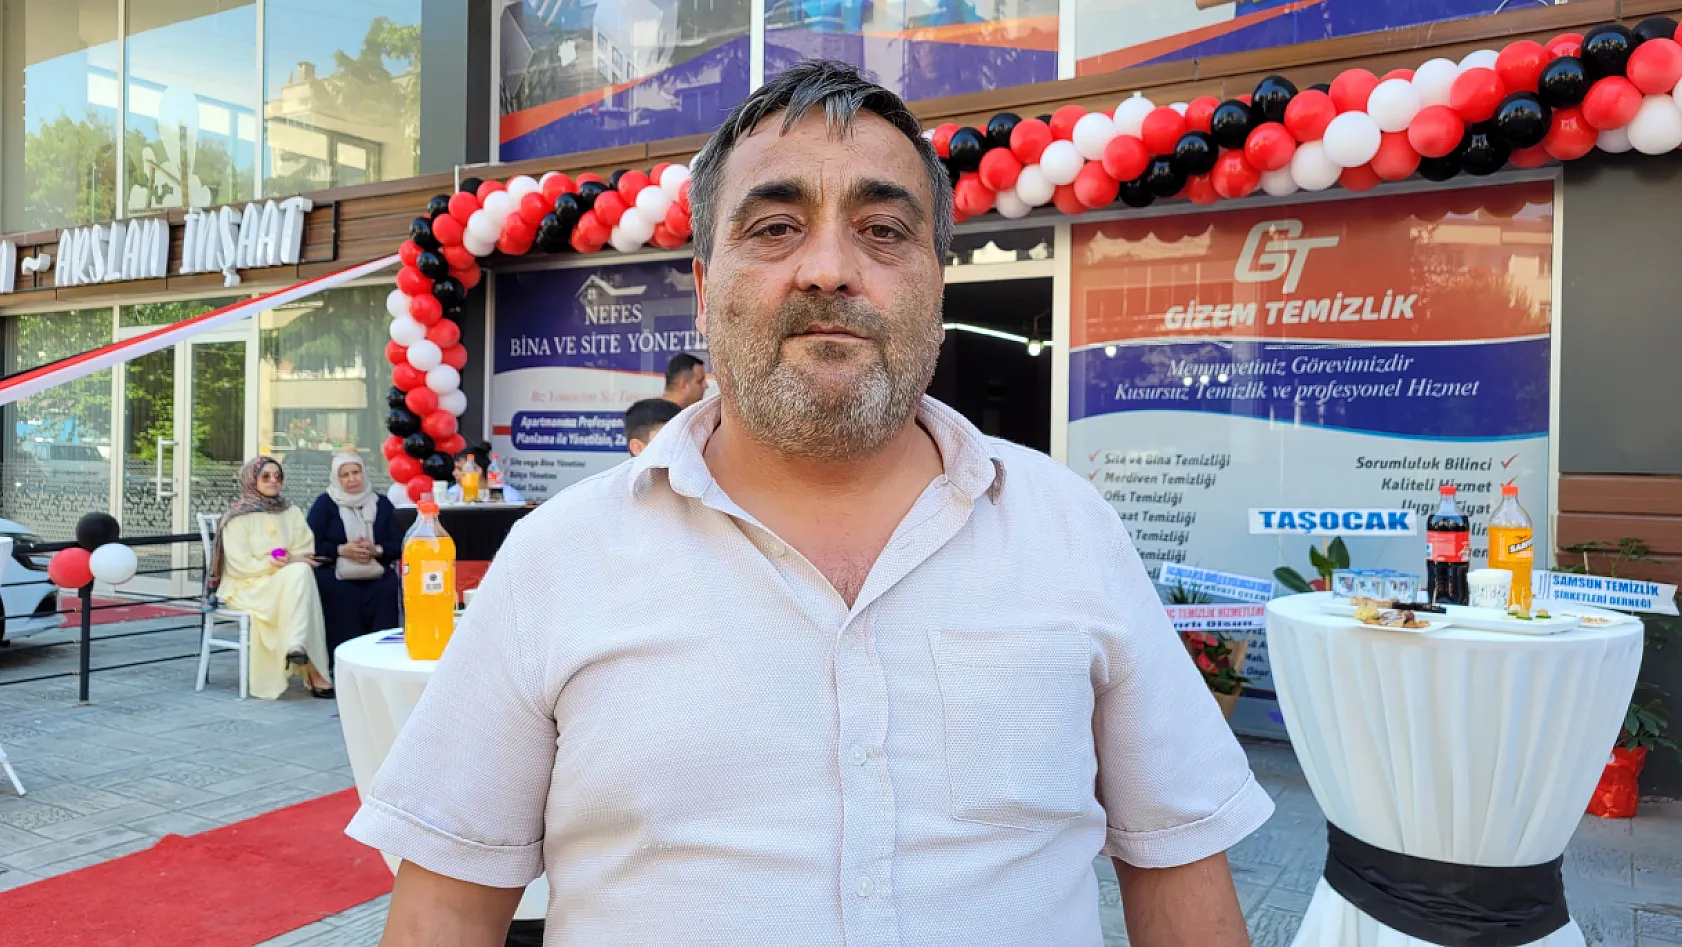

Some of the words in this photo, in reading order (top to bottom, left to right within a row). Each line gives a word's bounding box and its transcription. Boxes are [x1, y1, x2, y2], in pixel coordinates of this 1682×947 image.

[56, 218, 169, 287] ARSLAN
[180, 196, 313, 287] İNŞAAT
[585, 303, 642, 325] NEFES
[1165, 299, 1256, 330] GİZEM
[1266, 289, 1418, 323] TEMİZLİK
[510, 334, 551, 357] BİNA
[554, 336, 576, 355] VE
[580, 331, 621, 354] SİTE
[627, 329, 708, 352] YÖNETİ
[1291, 353, 1414, 375] Görevimizdir
[1115, 382, 1189, 400] Kusursuz
[1196, 380, 1267, 400] Temizlik
[1272, 386, 1292, 399] ve
[1294, 378, 1402, 403] profesyonel
[1407, 378, 1479, 398] Hizmet
[1175, 453, 1231, 470] Temizliği
[1355, 456, 1441, 470] Sorumluluk
[1444, 457, 1493, 471] Bilinci
[1104, 471, 1158, 483] Merdiven
[1161, 472, 1217, 489] Temizliği
[1381, 477, 1435, 491] Kaliteli
[1129, 491, 1184, 508] Temizliği
[1141, 510, 1197, 527] Temizliği
[1258, 510, 1412, 534] TAŞOCAK
[1136, 529, 1190, 545] Temizliği
[1552, 574, 1601, 589] SAMSUN
[1605, 579, 1660, 596] TEMİZLİK
